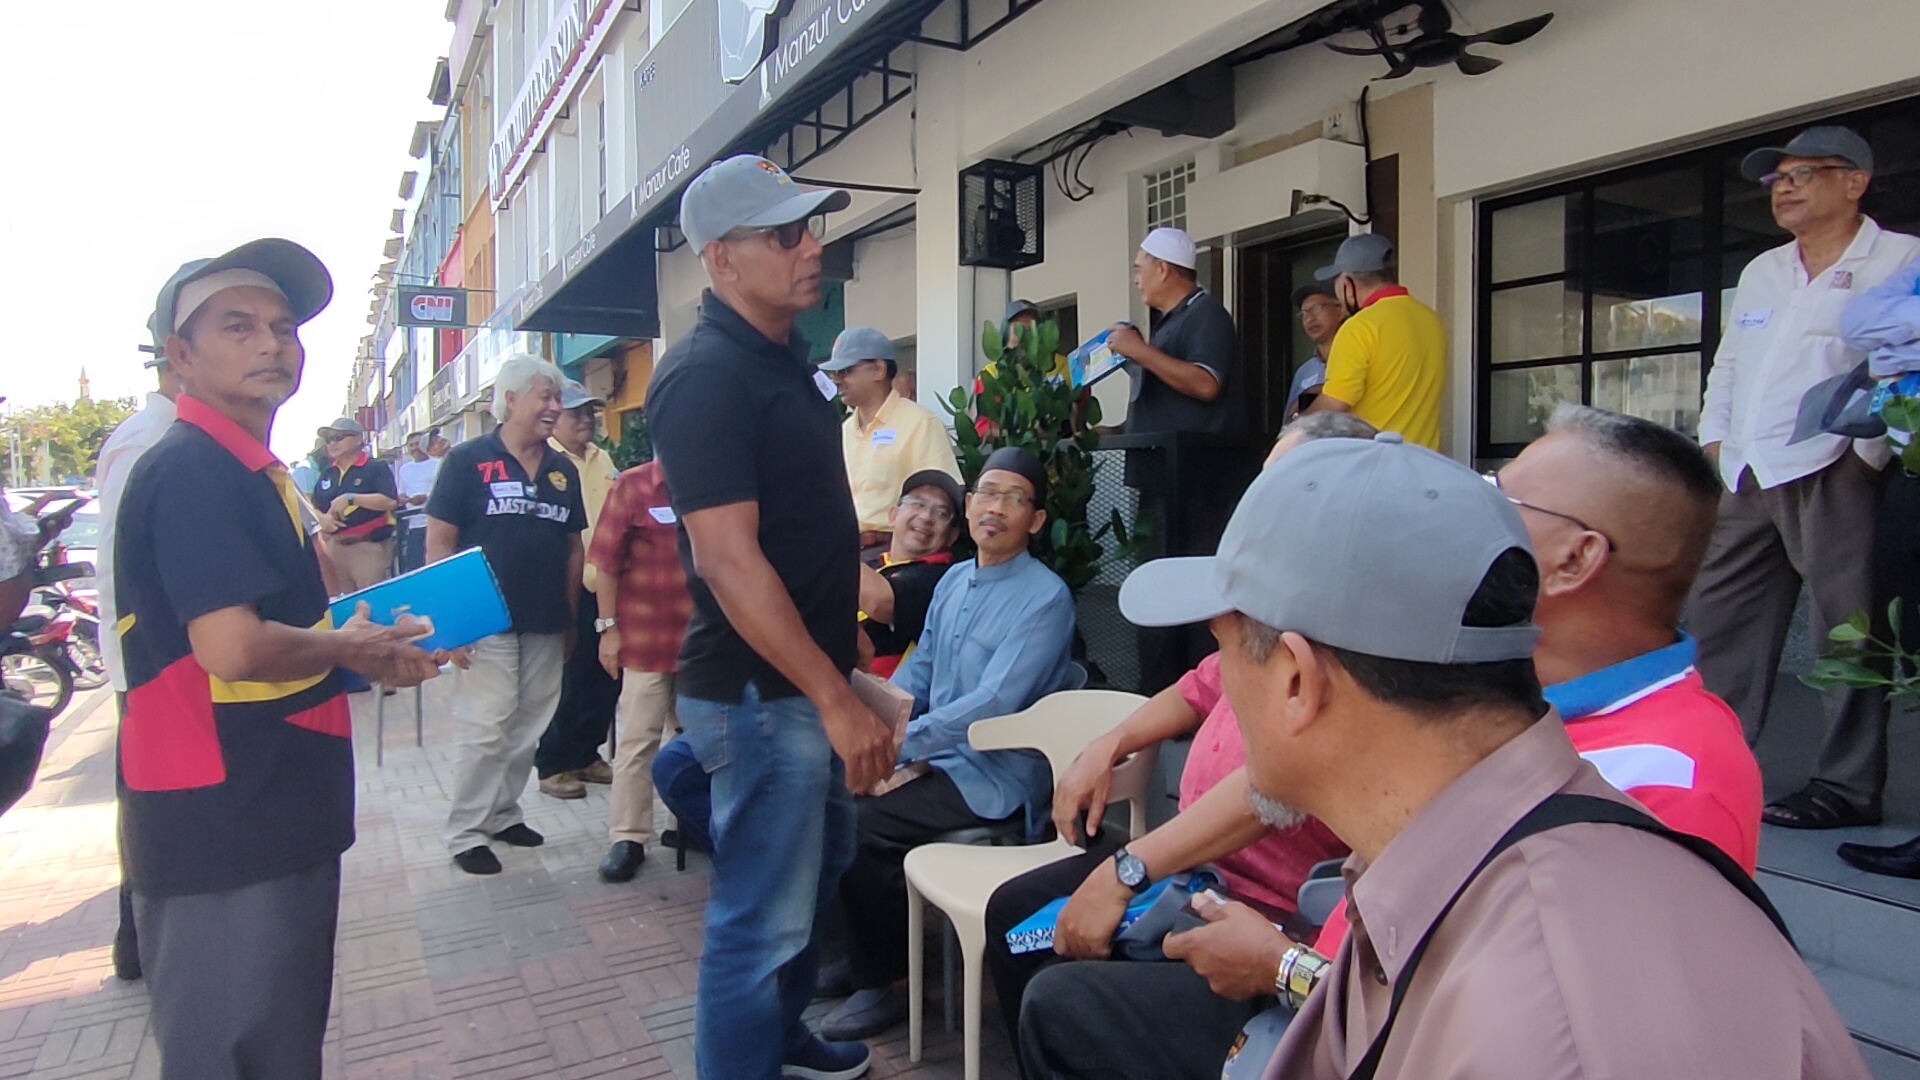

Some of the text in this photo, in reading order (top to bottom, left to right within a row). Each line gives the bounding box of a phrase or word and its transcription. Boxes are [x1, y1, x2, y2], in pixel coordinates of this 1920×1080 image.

[774, 6, 832, 84] Manzur
[638, 144, 691, 206] Manzur Cafe
[477, 460, 509, 483] 71
